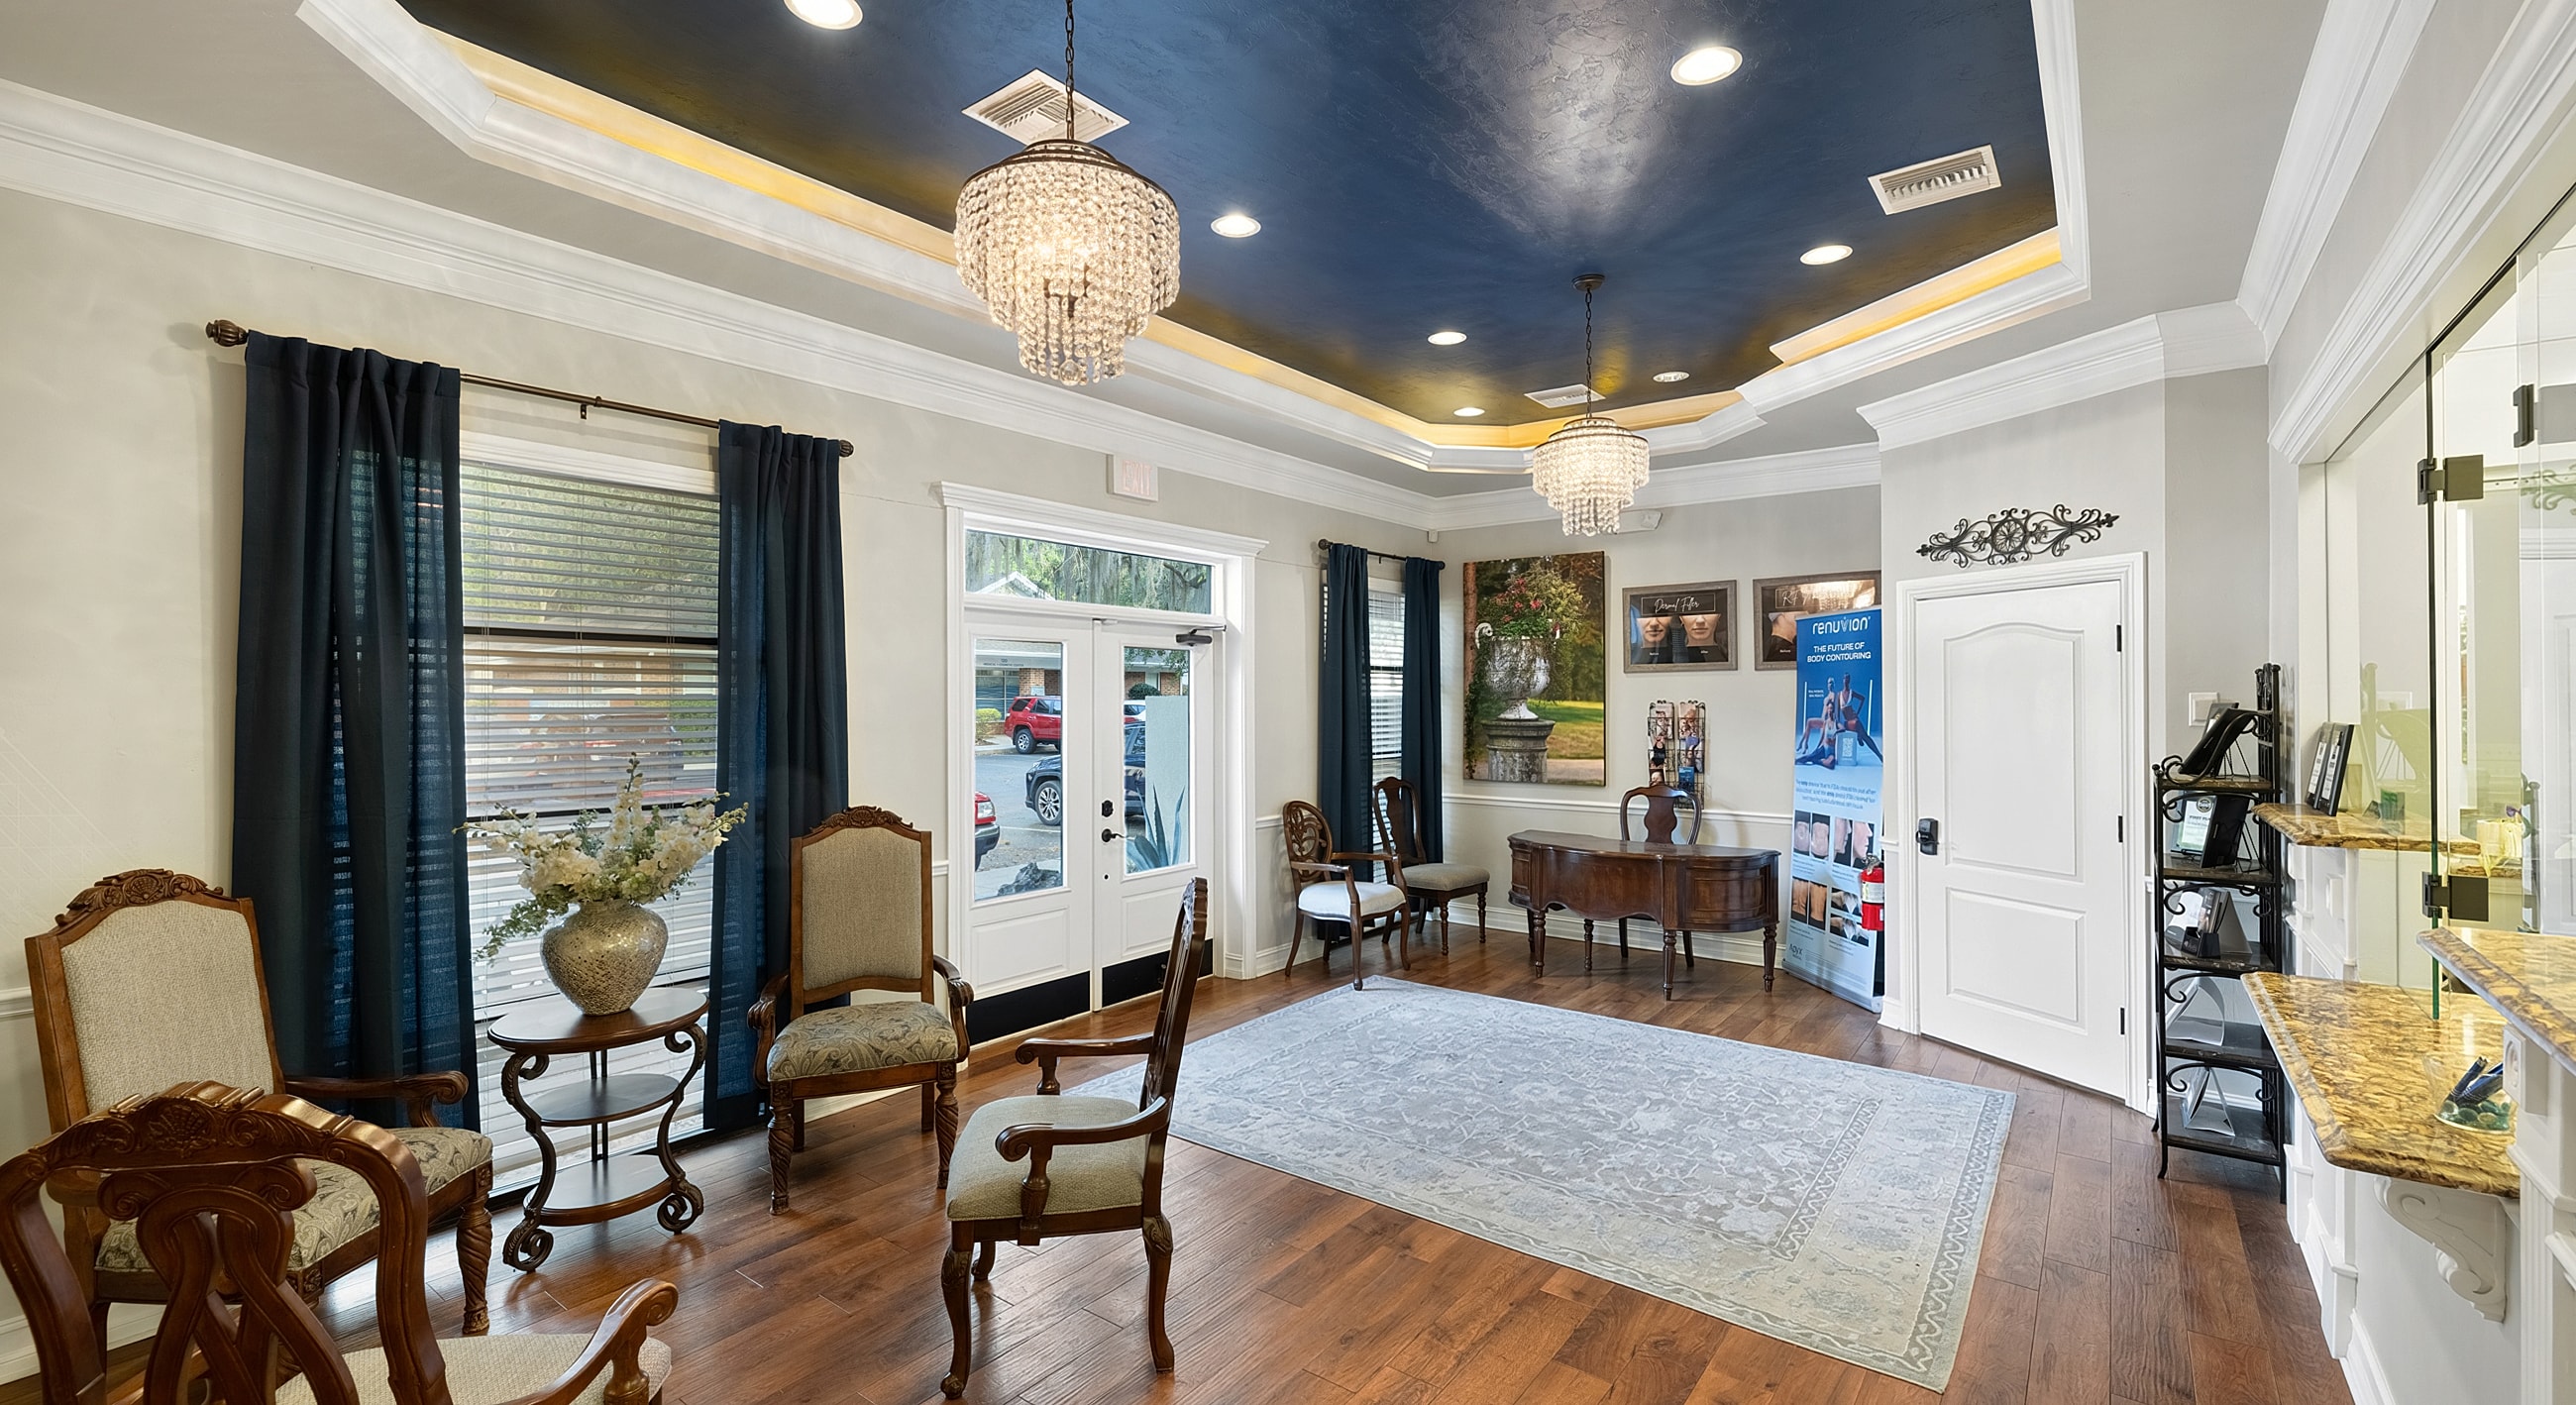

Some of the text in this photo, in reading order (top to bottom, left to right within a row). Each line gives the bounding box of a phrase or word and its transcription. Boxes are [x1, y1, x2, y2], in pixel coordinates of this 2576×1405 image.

[1122, 460, 1152, 496] EXIT
[1827, 643, 1854, 652] FUTURE
[1854, 641, 1866, 650] OF
[1806, 651, 1872, 663] BODY CONTOURING
